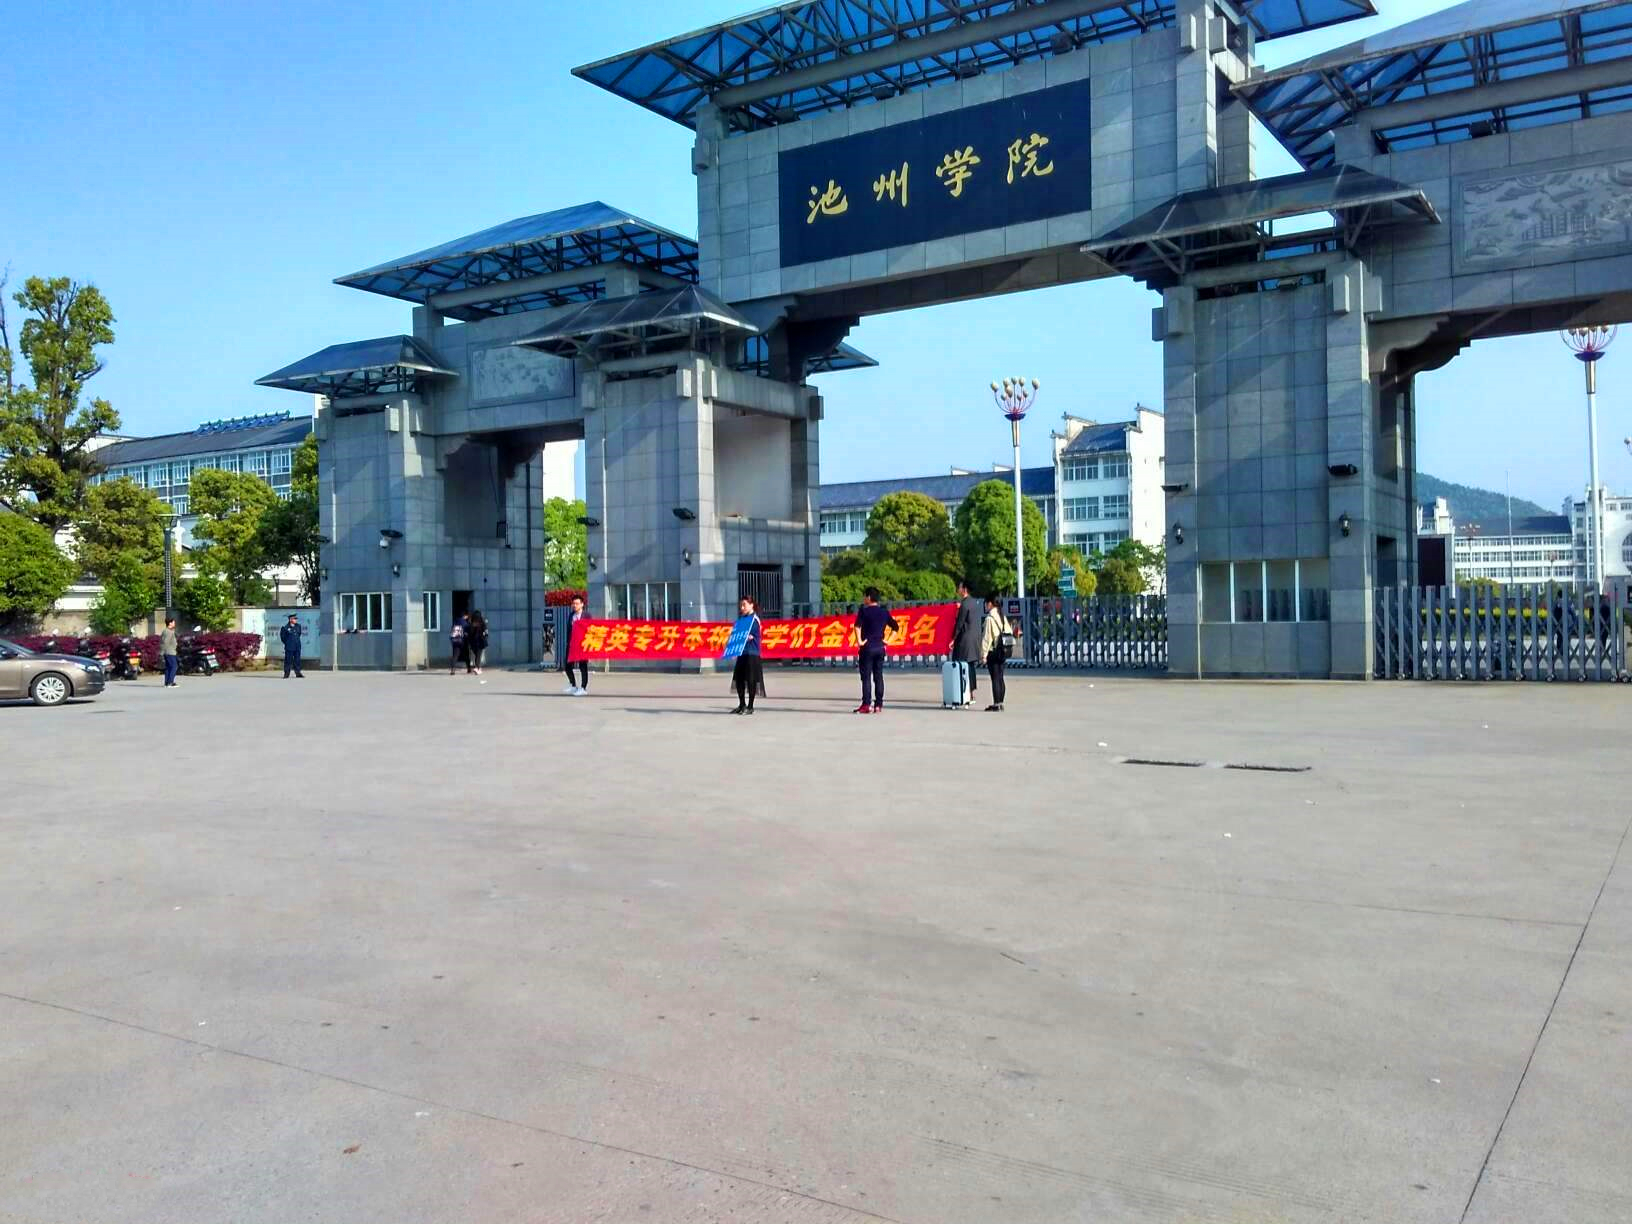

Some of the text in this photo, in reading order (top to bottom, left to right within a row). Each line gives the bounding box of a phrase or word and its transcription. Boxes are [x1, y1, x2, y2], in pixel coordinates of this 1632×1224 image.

[807, 133, 1054, 224] 池州学院
[581, 614, 938, 652] 精英专升本祝学们金题名
